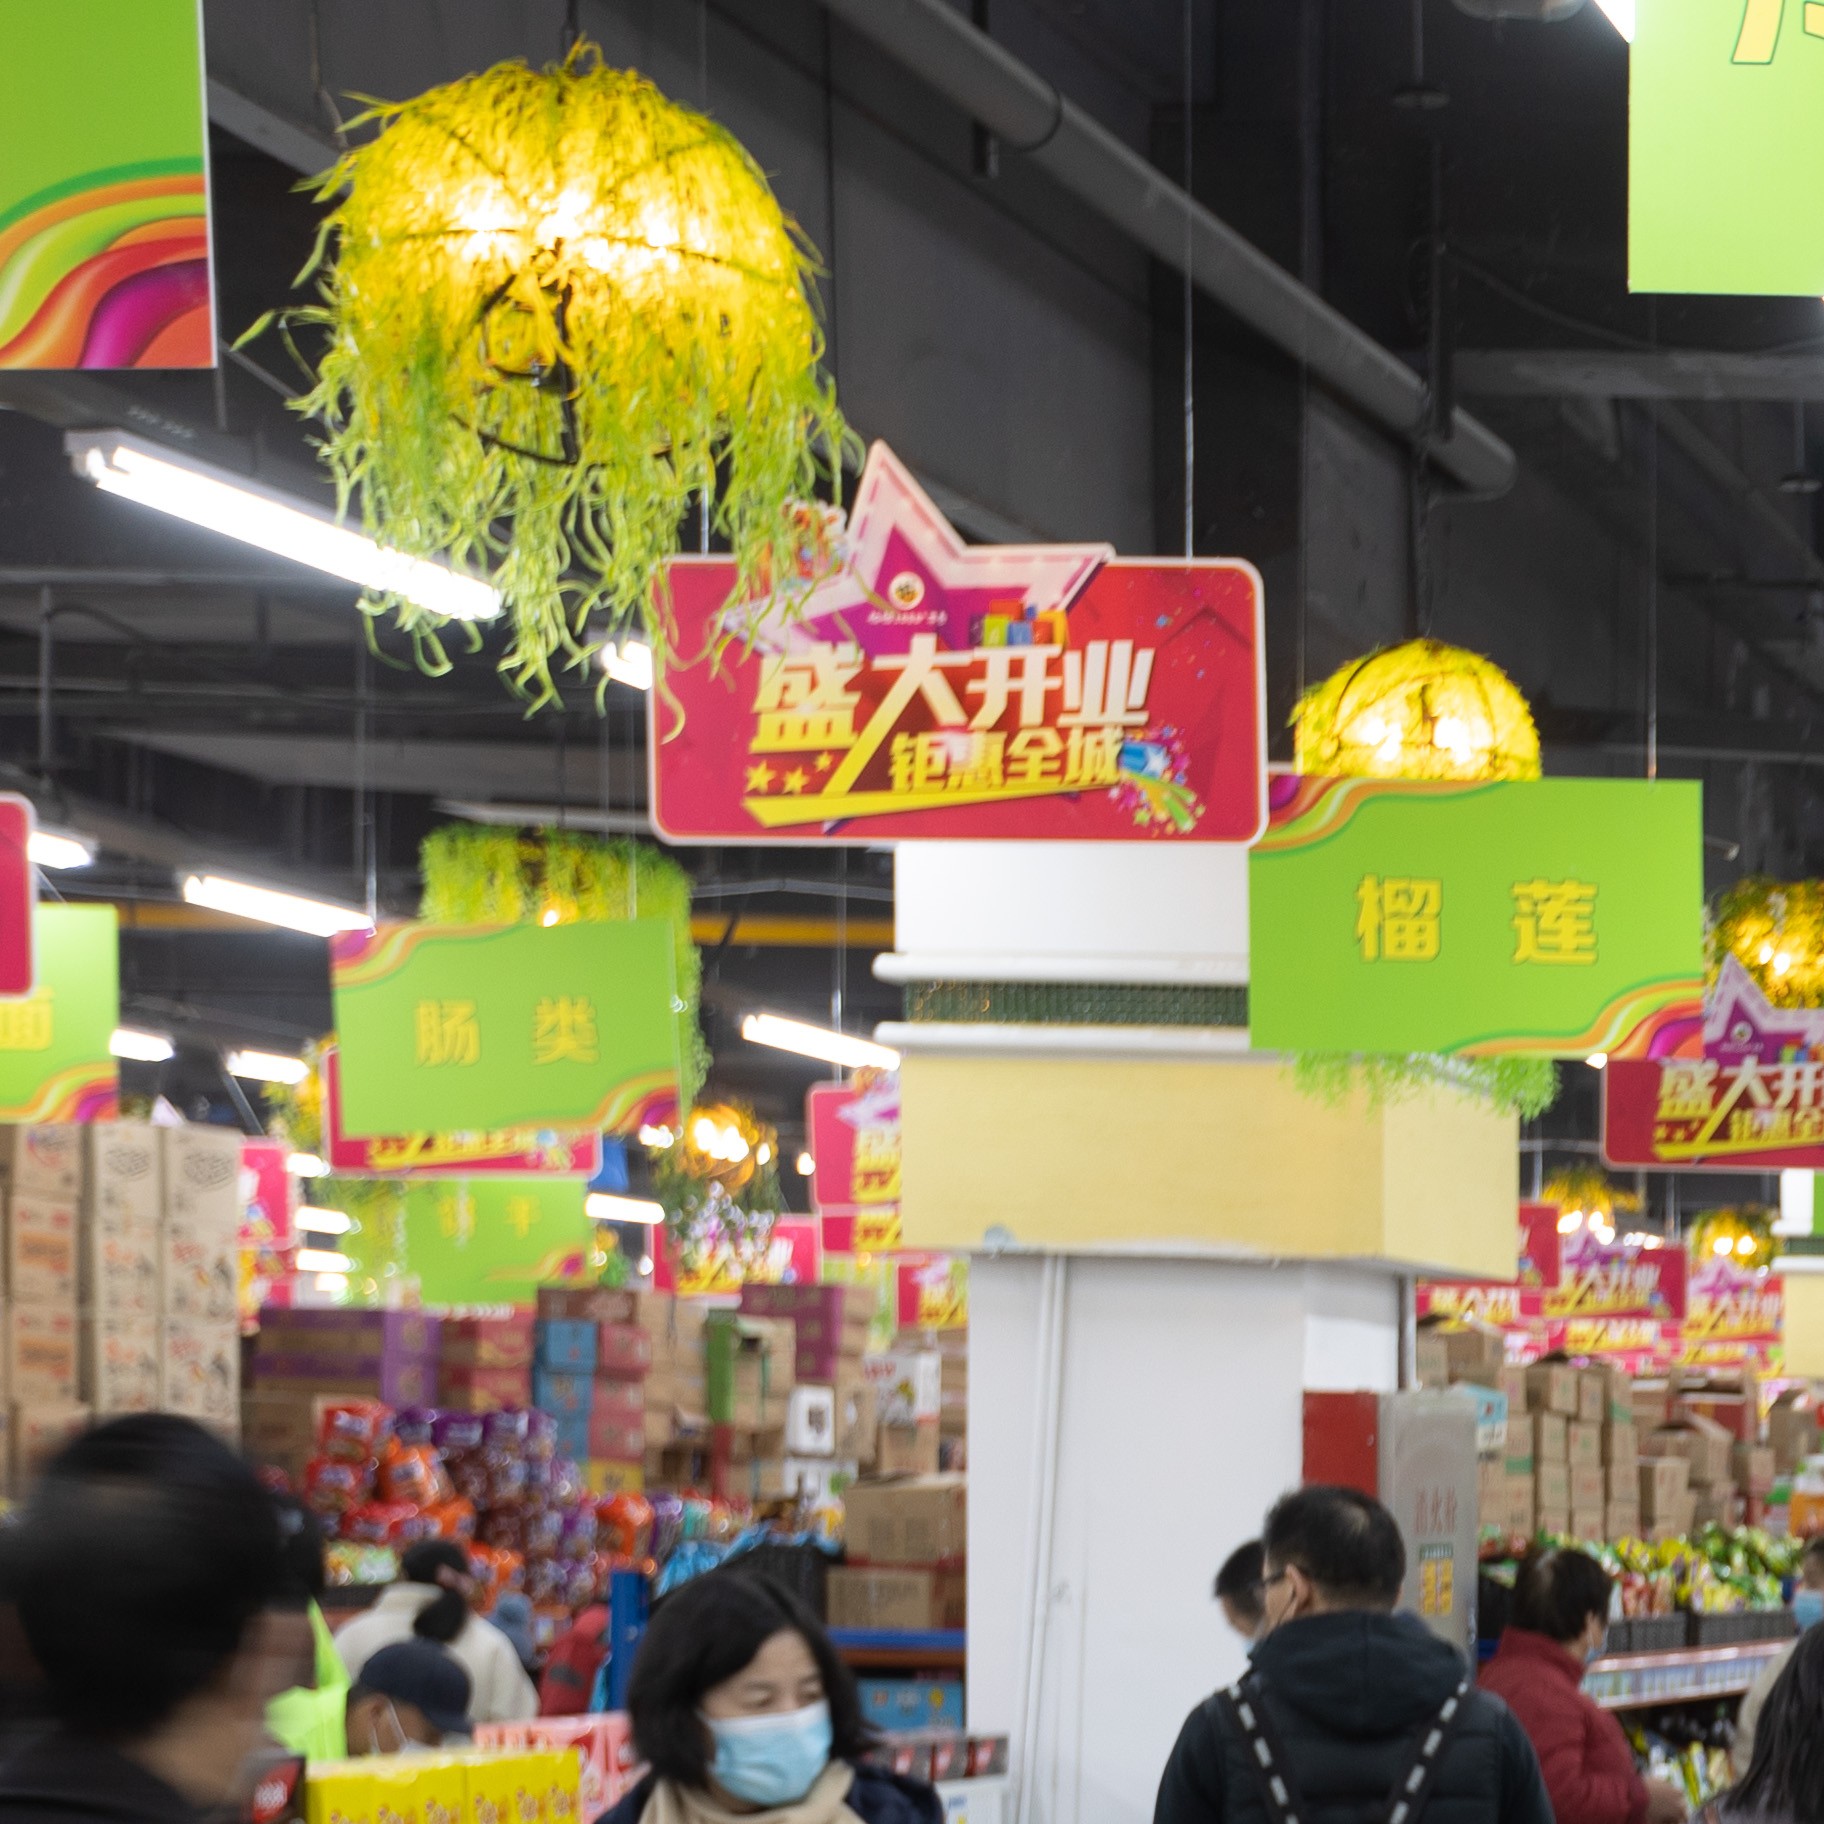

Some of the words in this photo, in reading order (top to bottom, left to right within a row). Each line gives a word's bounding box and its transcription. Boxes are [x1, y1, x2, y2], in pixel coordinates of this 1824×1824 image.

[750, 633, 1157, 772] 盛大开业
[889, 727, 1126, 791] 钜惠全城
[1354, 874, 1599, 965] 榴莲
[413, 996, 599, 1067] 肠类
